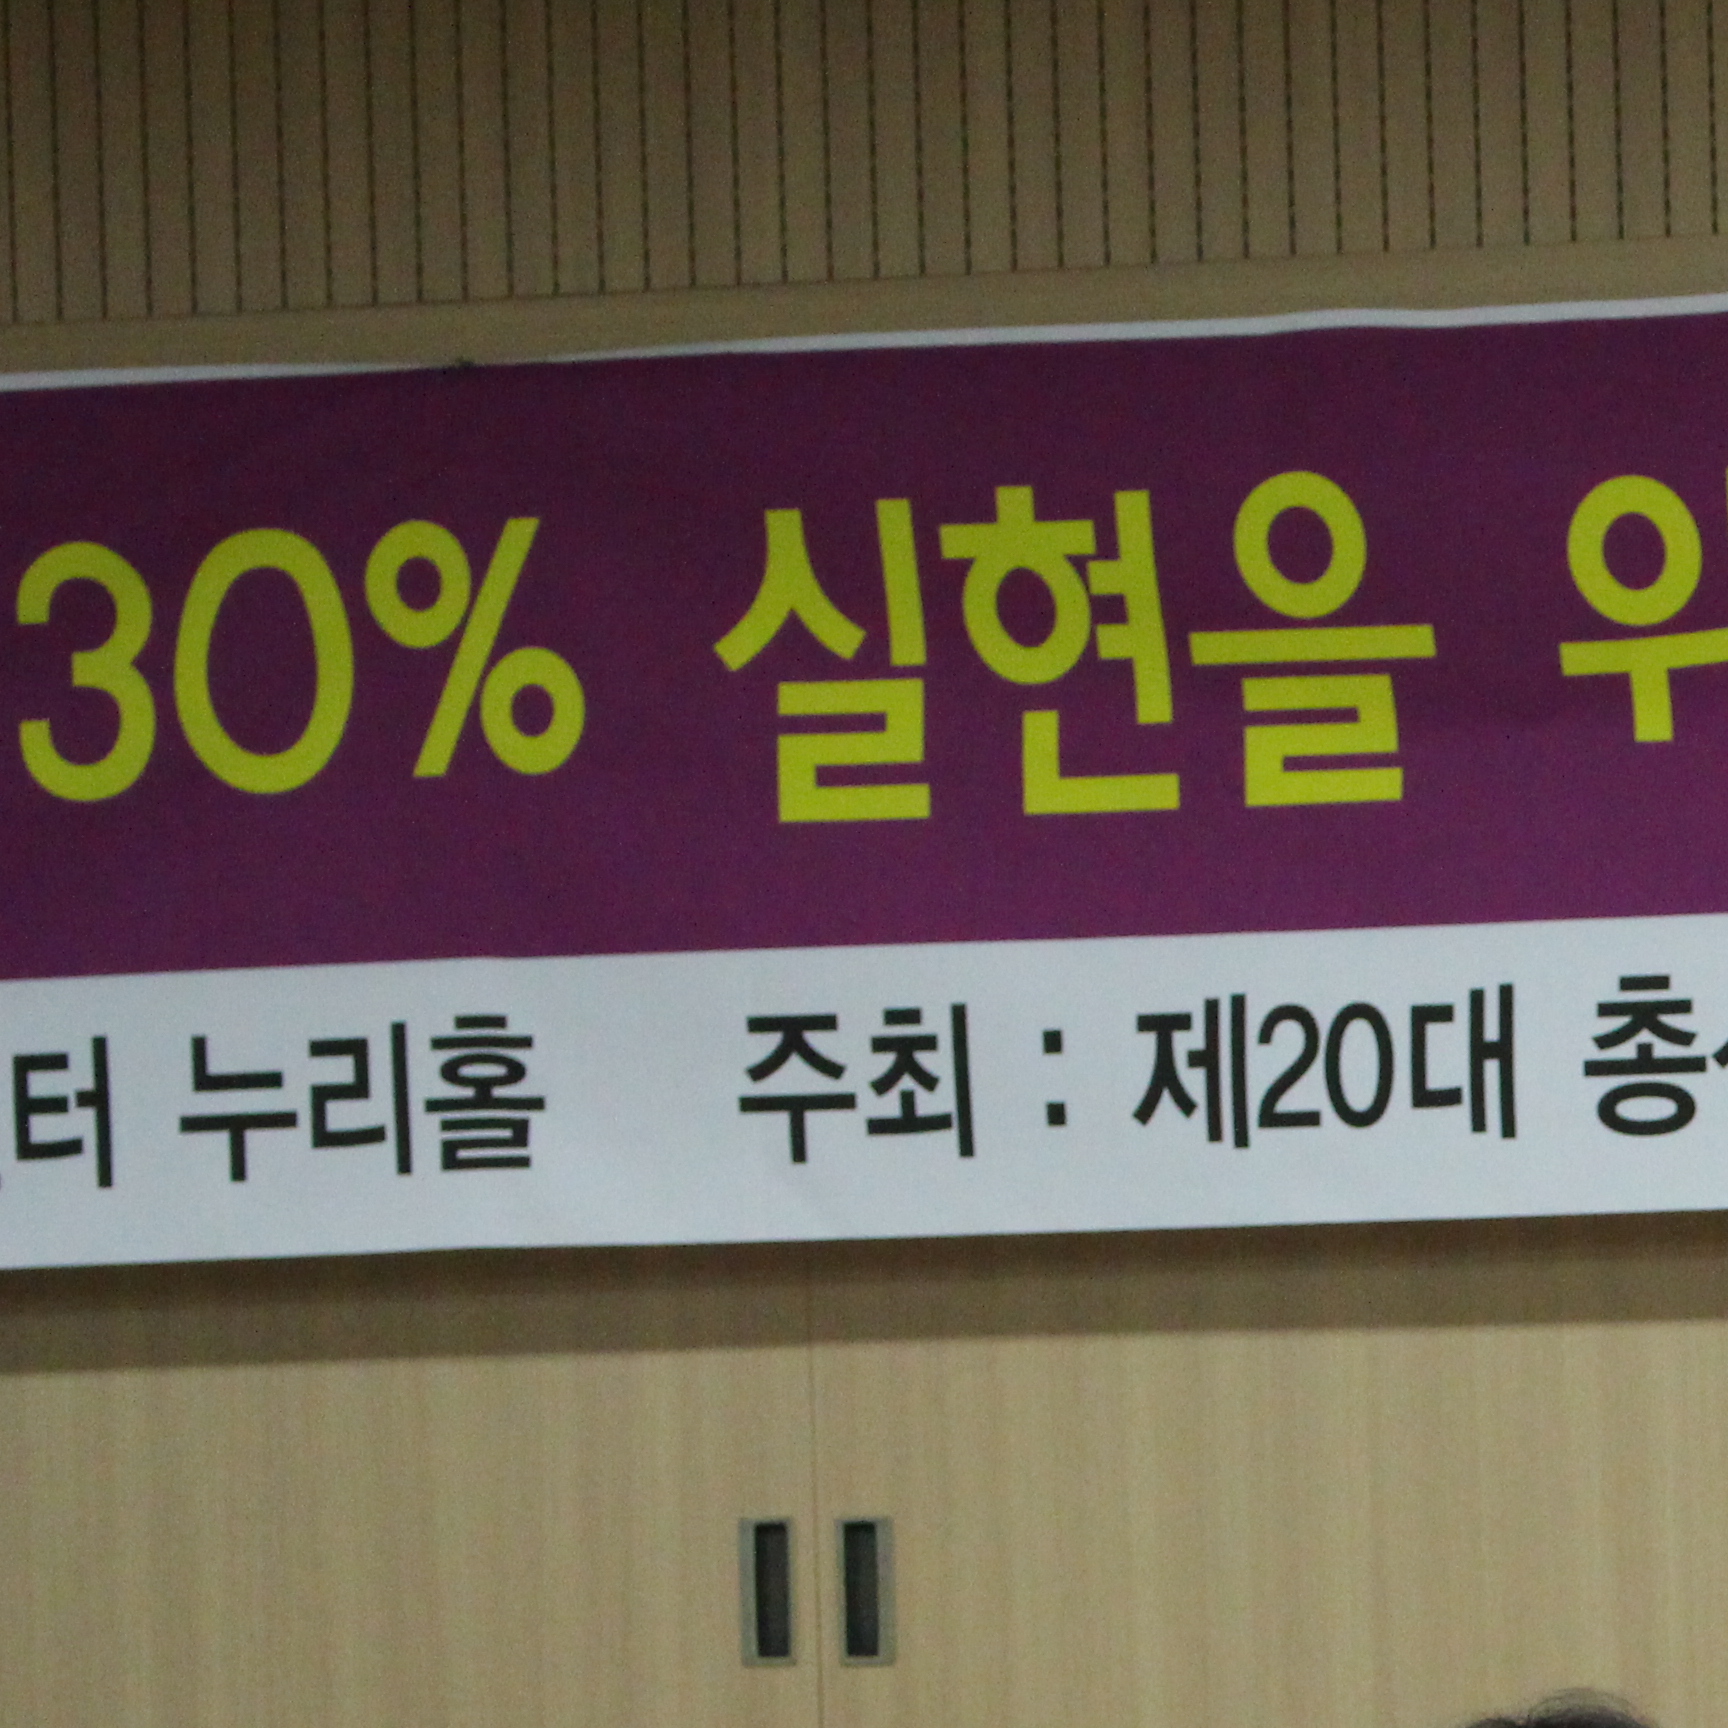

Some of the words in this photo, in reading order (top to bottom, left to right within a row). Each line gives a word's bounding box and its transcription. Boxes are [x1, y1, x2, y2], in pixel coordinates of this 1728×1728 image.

[19, 519, 584, 800] 30%
[716, 472, 1435, 821] 실현을
[13, 1036, 113, 1188] 터
[180, 1015, 545, 1182] 누리홀
[739, 1004, 974, 1163] 주최
[1043, 1030, 1066, 1126] :
[1133, 984, 1516, 1148] 제20대
